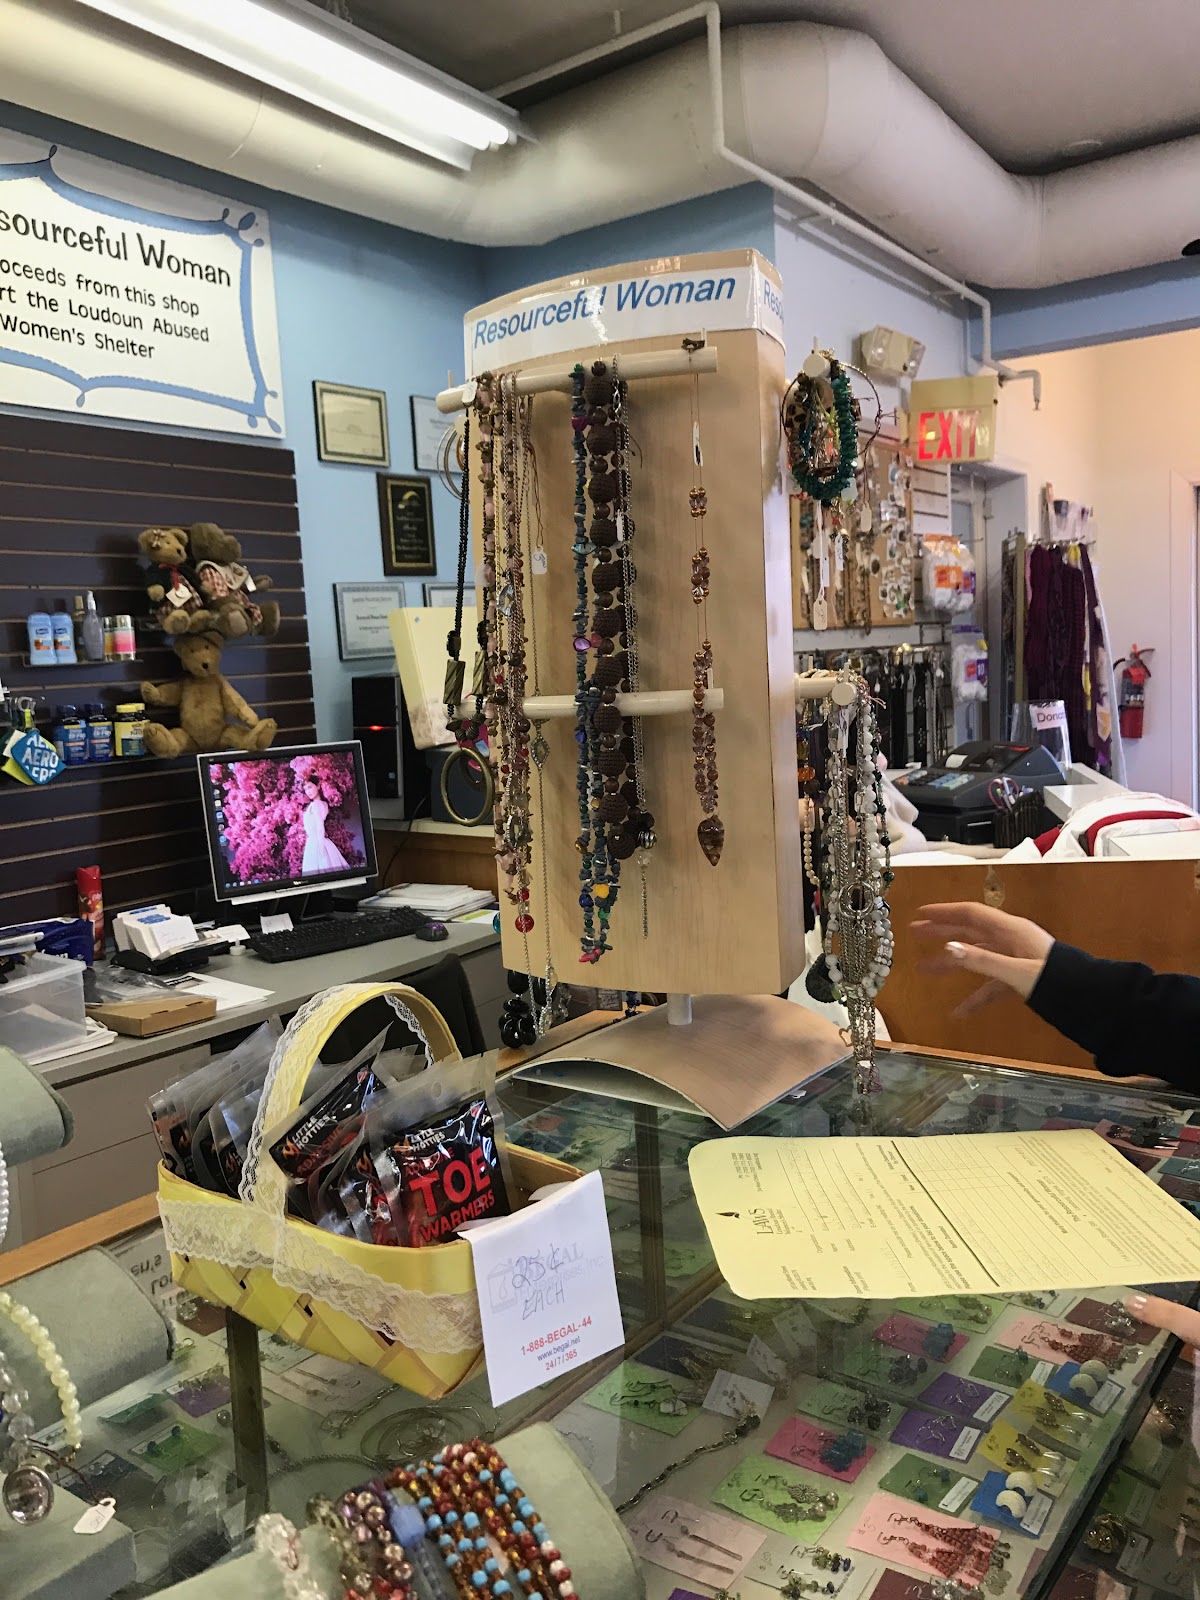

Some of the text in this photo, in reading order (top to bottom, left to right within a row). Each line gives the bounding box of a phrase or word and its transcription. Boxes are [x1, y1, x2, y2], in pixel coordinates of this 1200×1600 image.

[136, 232, 232, 287] Woman
[76, 273, 120, 299] from
[124, 285, 156, 307] this
[162, 294, 200, 317] shop
[616, 276, 737, 312] Woman
[0, 313, 155, 358] Women's Shelter
[26, 290, 59, 312] the
[69, 299, 143, 330] Loudoun
[153, 317, 210, 342] Abused
[917, 410, 980, 461] EXIT
[21, 746, 59, 769] AERO
[291, 1115, 317, 1144] LITTLE
[295, 1114, 331, 1150] HOTTIES
[410, 1127, 436, 1144] LITTLE
[412, 1131, 446, 1152] HOTTIES
[408, 1146, 491, 1217] TOE
[419, 1189, 495, 1243] WARMERS
[745, 1207, 775, 1234] LAWS
[522, 1279, 565, 1320] EACH
[521, 1316, 592, 1356] 1-888-BEGAL-44
[536, 1335, 582, 1362] www.begal.net
